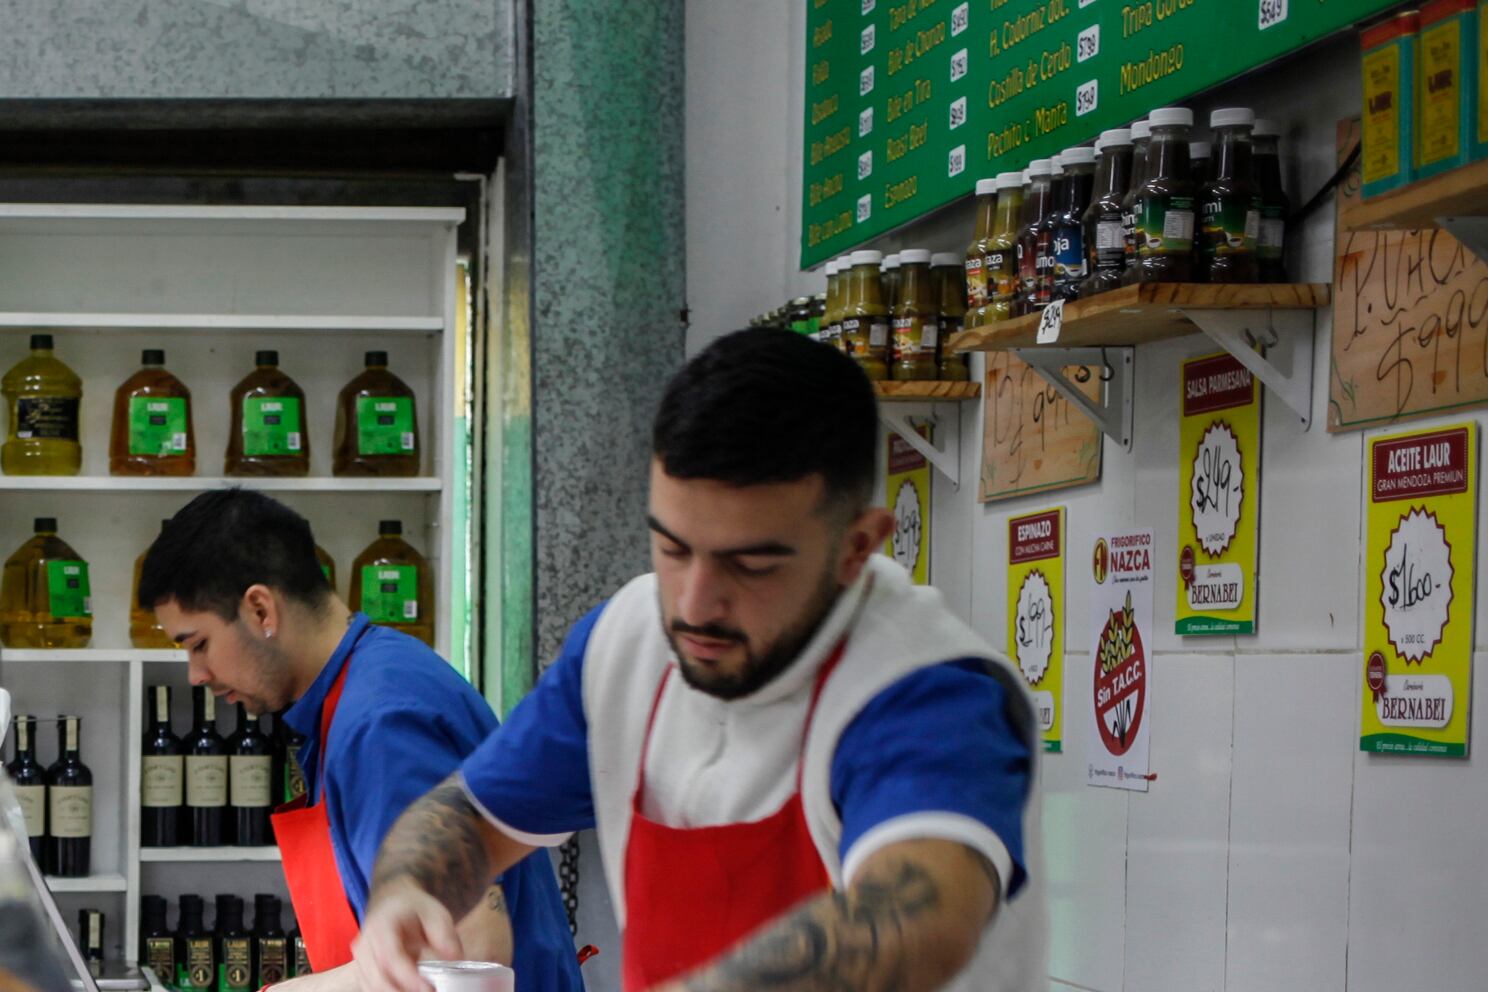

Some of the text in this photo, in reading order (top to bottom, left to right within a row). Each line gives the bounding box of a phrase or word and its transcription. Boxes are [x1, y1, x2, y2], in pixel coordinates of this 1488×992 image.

[1120, 45, 1184, 95] Mondongo
[1187, 378, 1207, 400] SALSA
[1388, 442, 1450, 474] ACEITE LAUR
[1377, 477, 1396, 491] GRAN
[1398, 474, 1432, 489] MENDOZA
[1018, 520, 1052, 542] ESPINAZO
[1111, 534, 1151, 548] FRIGORIFICO
[1110, 549, 1150, 572] NAZCA
[1192, 583, 1239, 604] BERNABEI
[1097, 686, 1111, 708] Sin
[1382, 697, 1446, 721] BERNABEI
